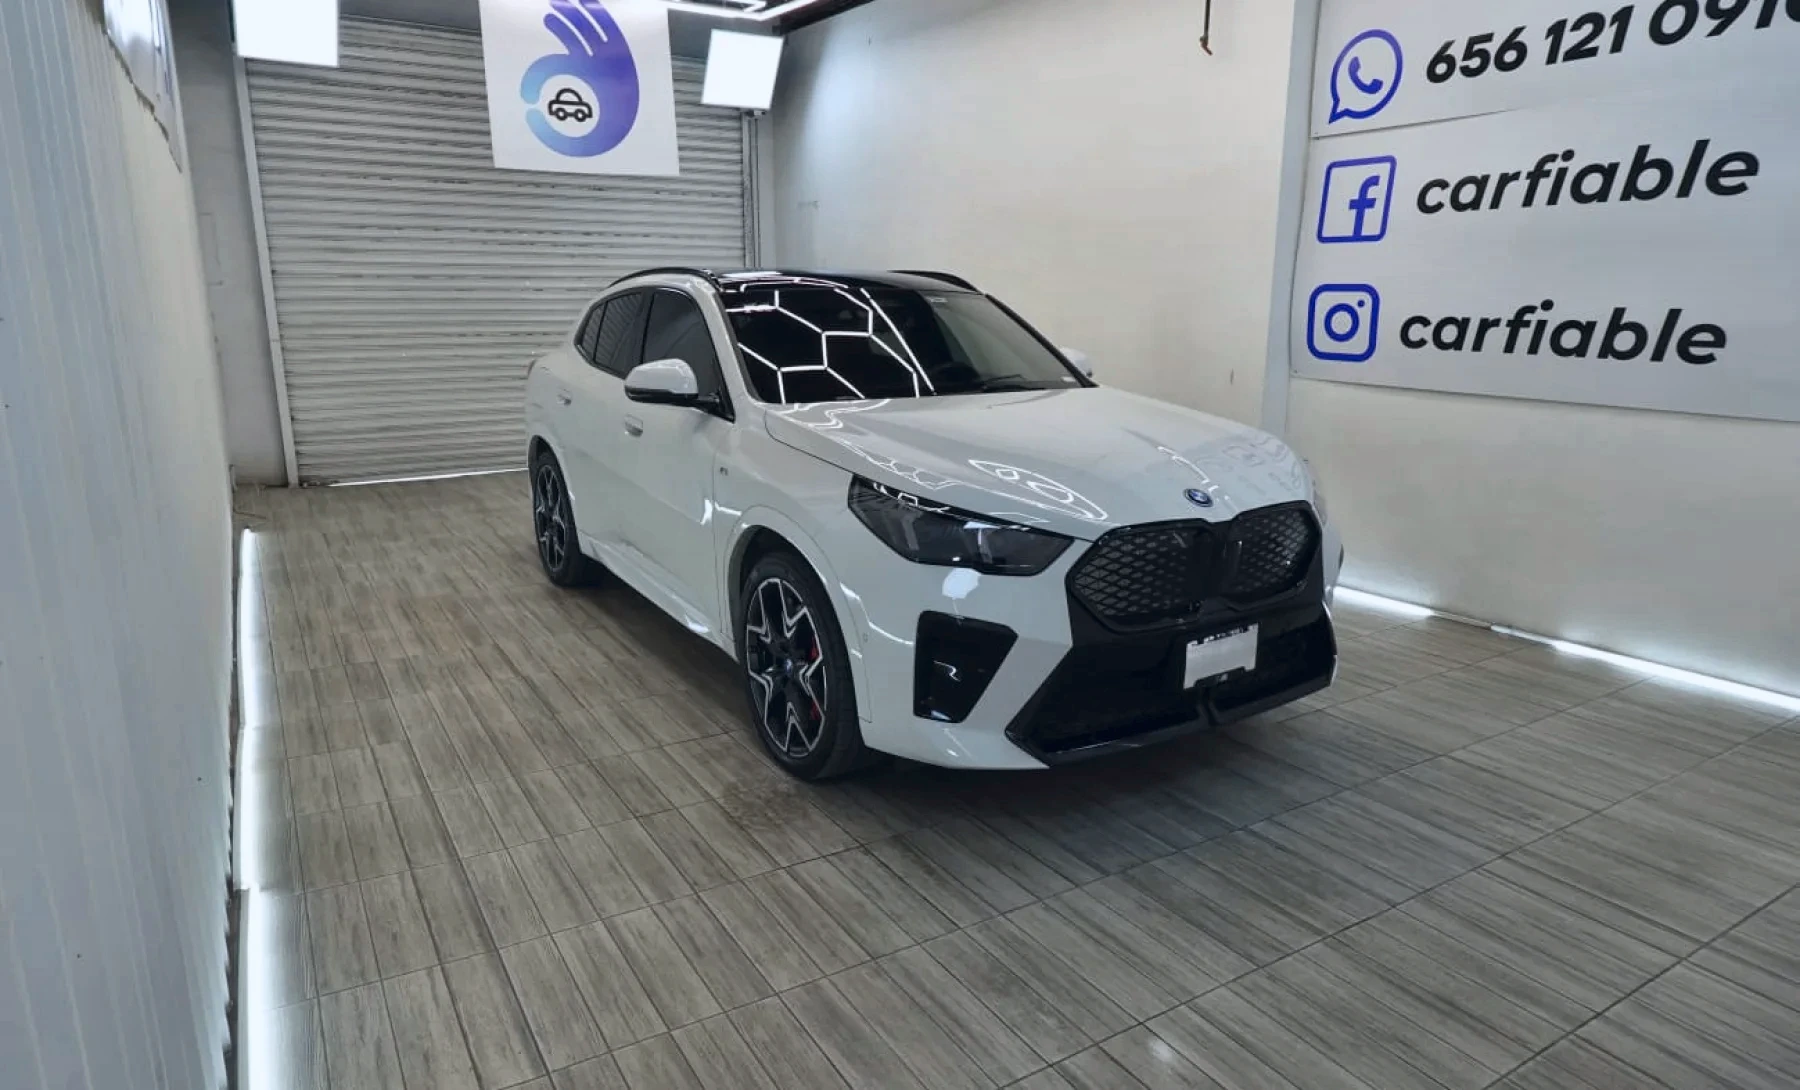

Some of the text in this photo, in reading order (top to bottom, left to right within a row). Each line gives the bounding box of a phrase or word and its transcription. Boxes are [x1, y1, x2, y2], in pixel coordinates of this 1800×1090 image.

[1426, 0, 1800, 84] 656 121 091
[1416, 139, 1760, 214] carfiable
[1399, 299, 1727, 365] carfiable
